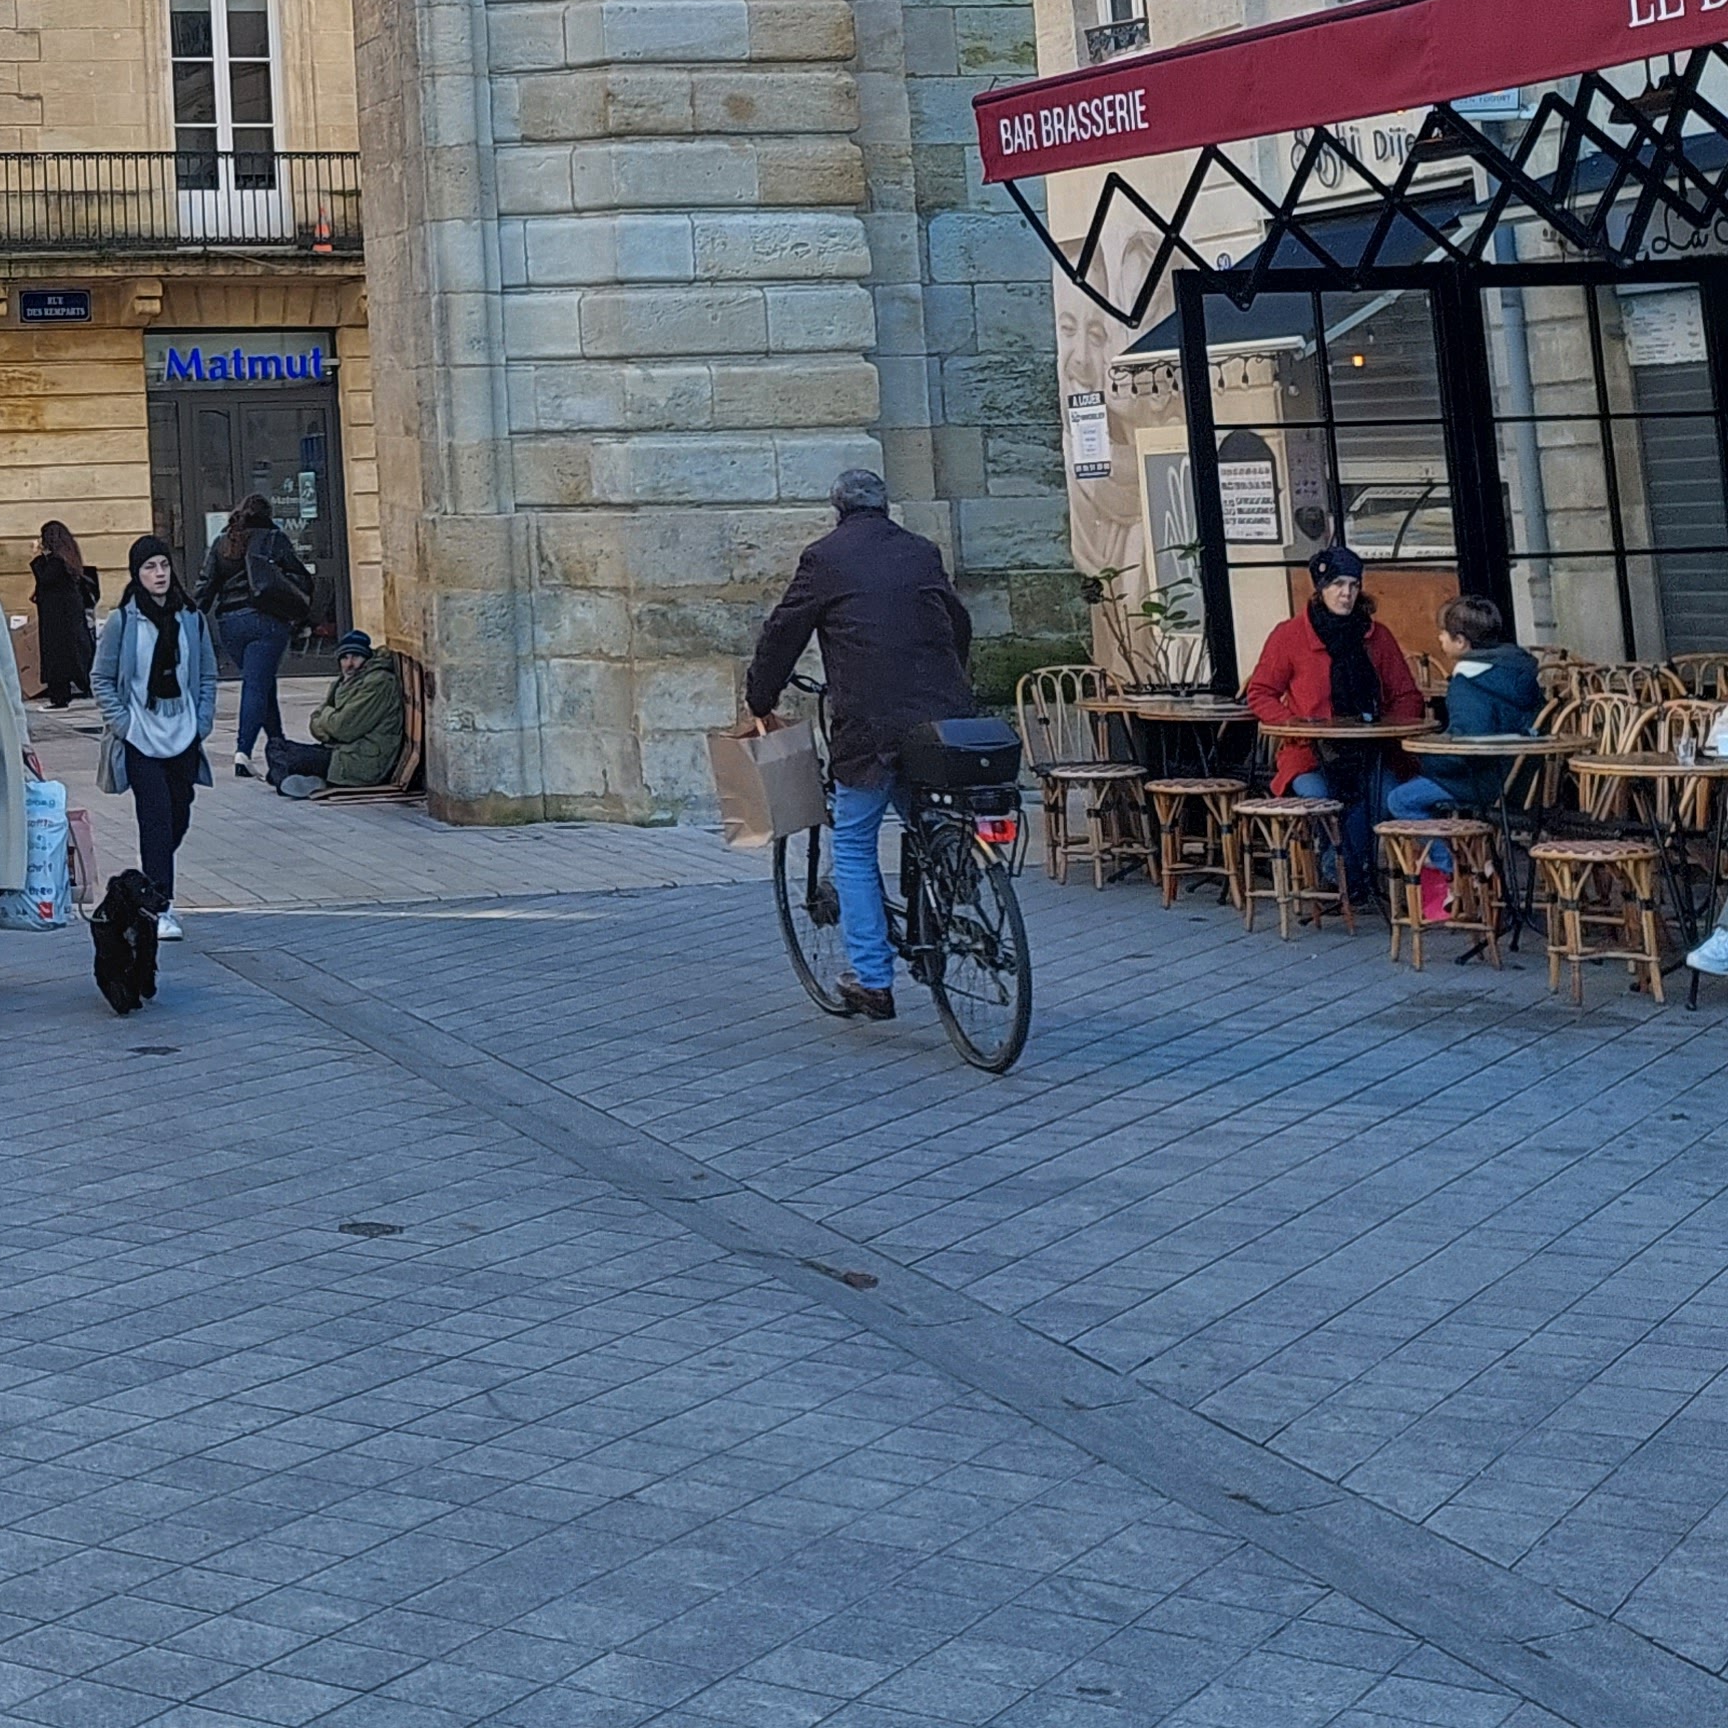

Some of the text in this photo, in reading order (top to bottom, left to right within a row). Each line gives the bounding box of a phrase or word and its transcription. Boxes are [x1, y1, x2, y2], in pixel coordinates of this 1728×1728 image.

[999, 88, 1150, 156] BAR BRASSERIE
[47, 296, 64, 305] RUE
[26, 307, 85, 317] DES REMPARTS
[162, 346, 323, 382] Matmut
[1079, 393, 1101, 407] LOUER
